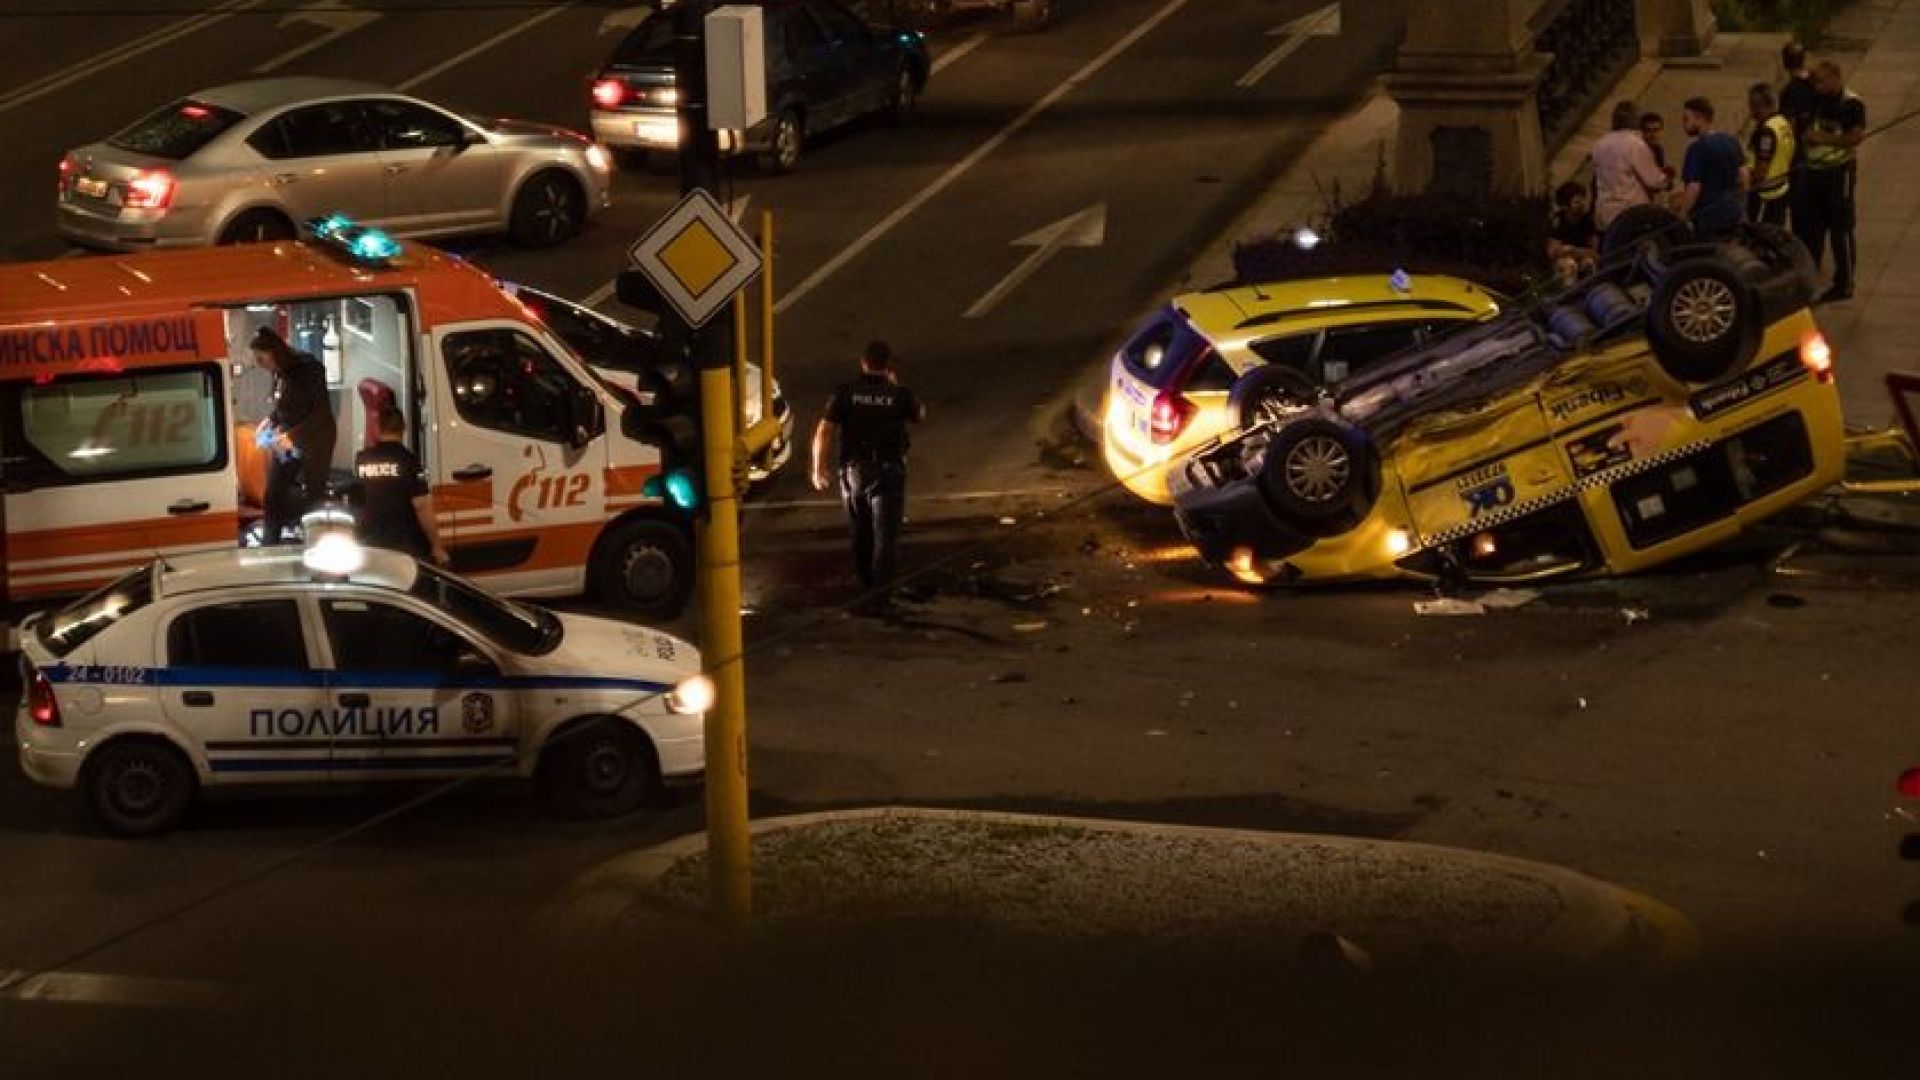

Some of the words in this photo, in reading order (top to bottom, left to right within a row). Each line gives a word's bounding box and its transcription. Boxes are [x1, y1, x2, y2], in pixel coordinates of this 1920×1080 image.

[90, 318, 200, 359] ПОМОЩ
[851, 393, 895, 406] POLICE
[128, 403, 197, 444] 112
[358, 463, 399, 478] POLICE
[538, 474, 589, 509] 112
[250, 706, 438, 740] ПОЛИЦИЯ
